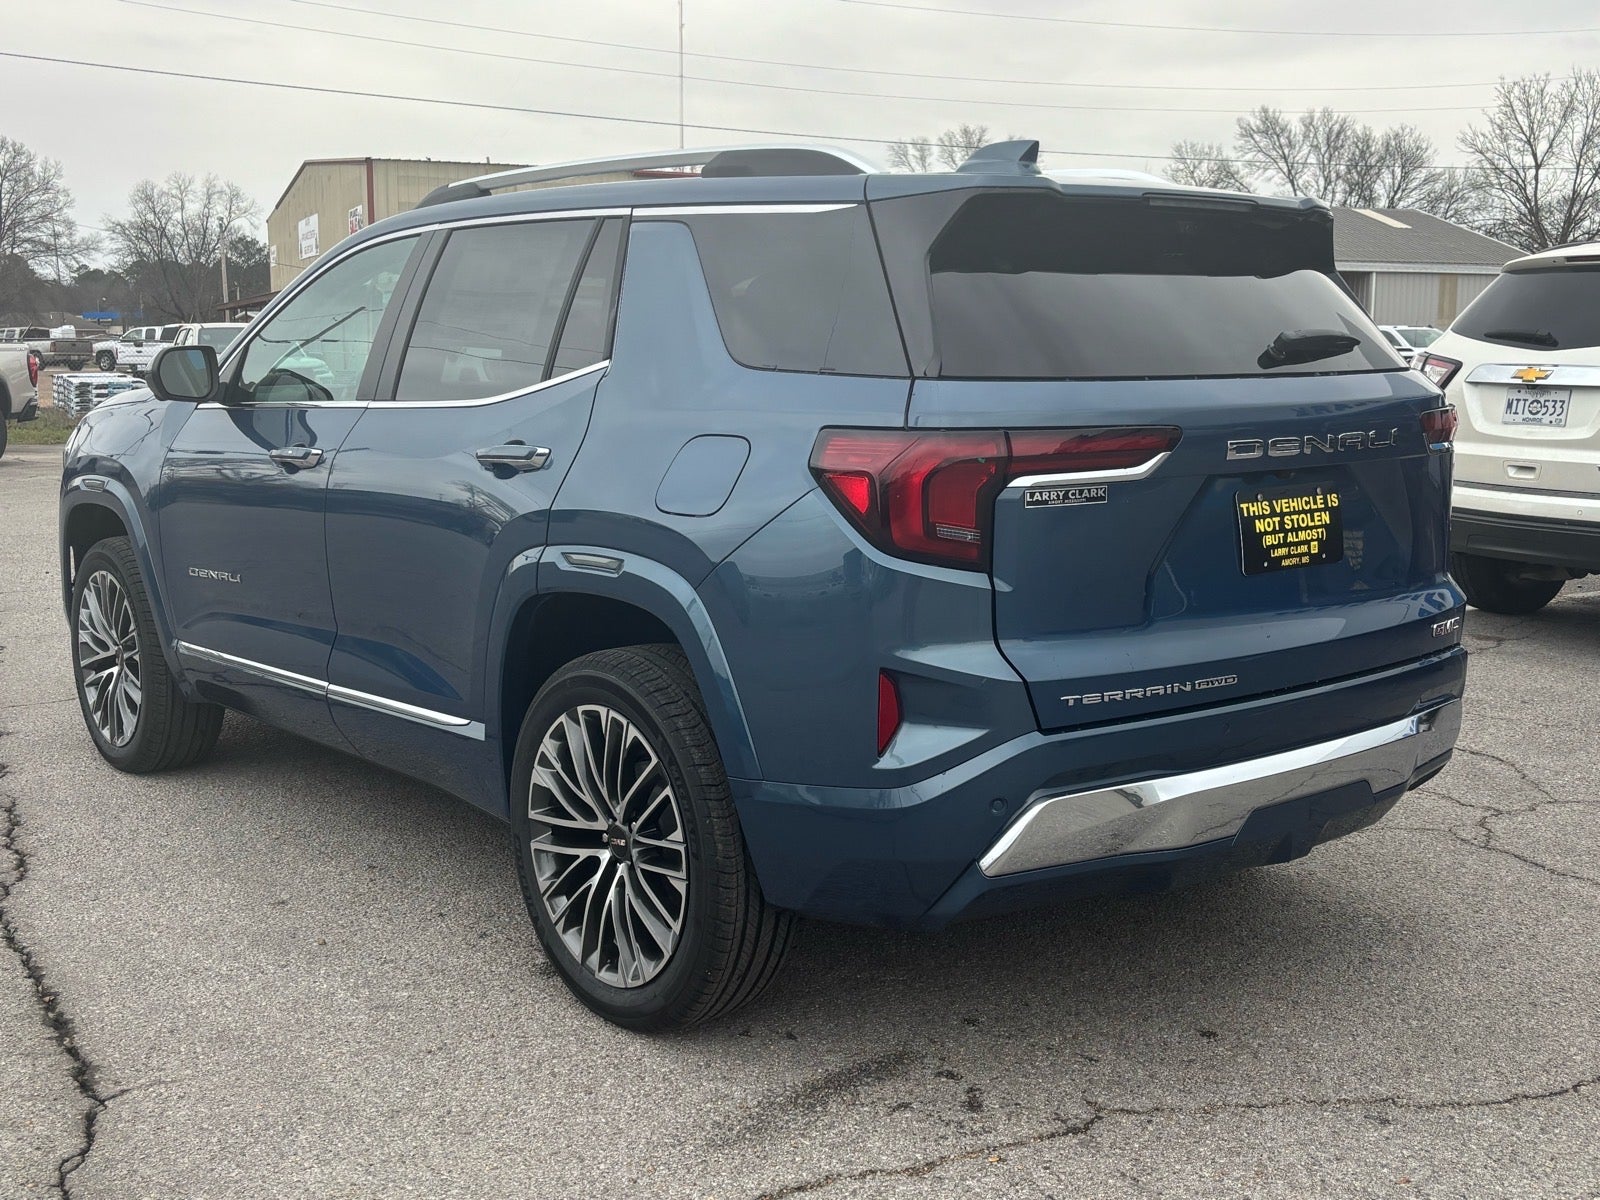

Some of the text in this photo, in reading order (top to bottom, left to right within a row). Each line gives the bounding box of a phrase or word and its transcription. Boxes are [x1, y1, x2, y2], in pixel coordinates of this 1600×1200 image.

[1541, 399, 1566, 416] 533
[1226, 427, 1398, 460] DENALI
[1026, 488, 1105, 502] LARRY CLARK
[1240, 493, 1339, 517] THIS VEHICLE IS
[1255, 511, 1330, 533] NOT STOLEN
[1262, 528, 1326, 548] (BUT ALMOST)
[1270, 546, 1288, 557] LARRY
[1290, 544, 1309, 555] CLARK
[188, 567, 241, 583] DENALI
[1432, 616, 1460, 637] GMC
[1060, 674, 1238, 707] TERRAIN AWD
